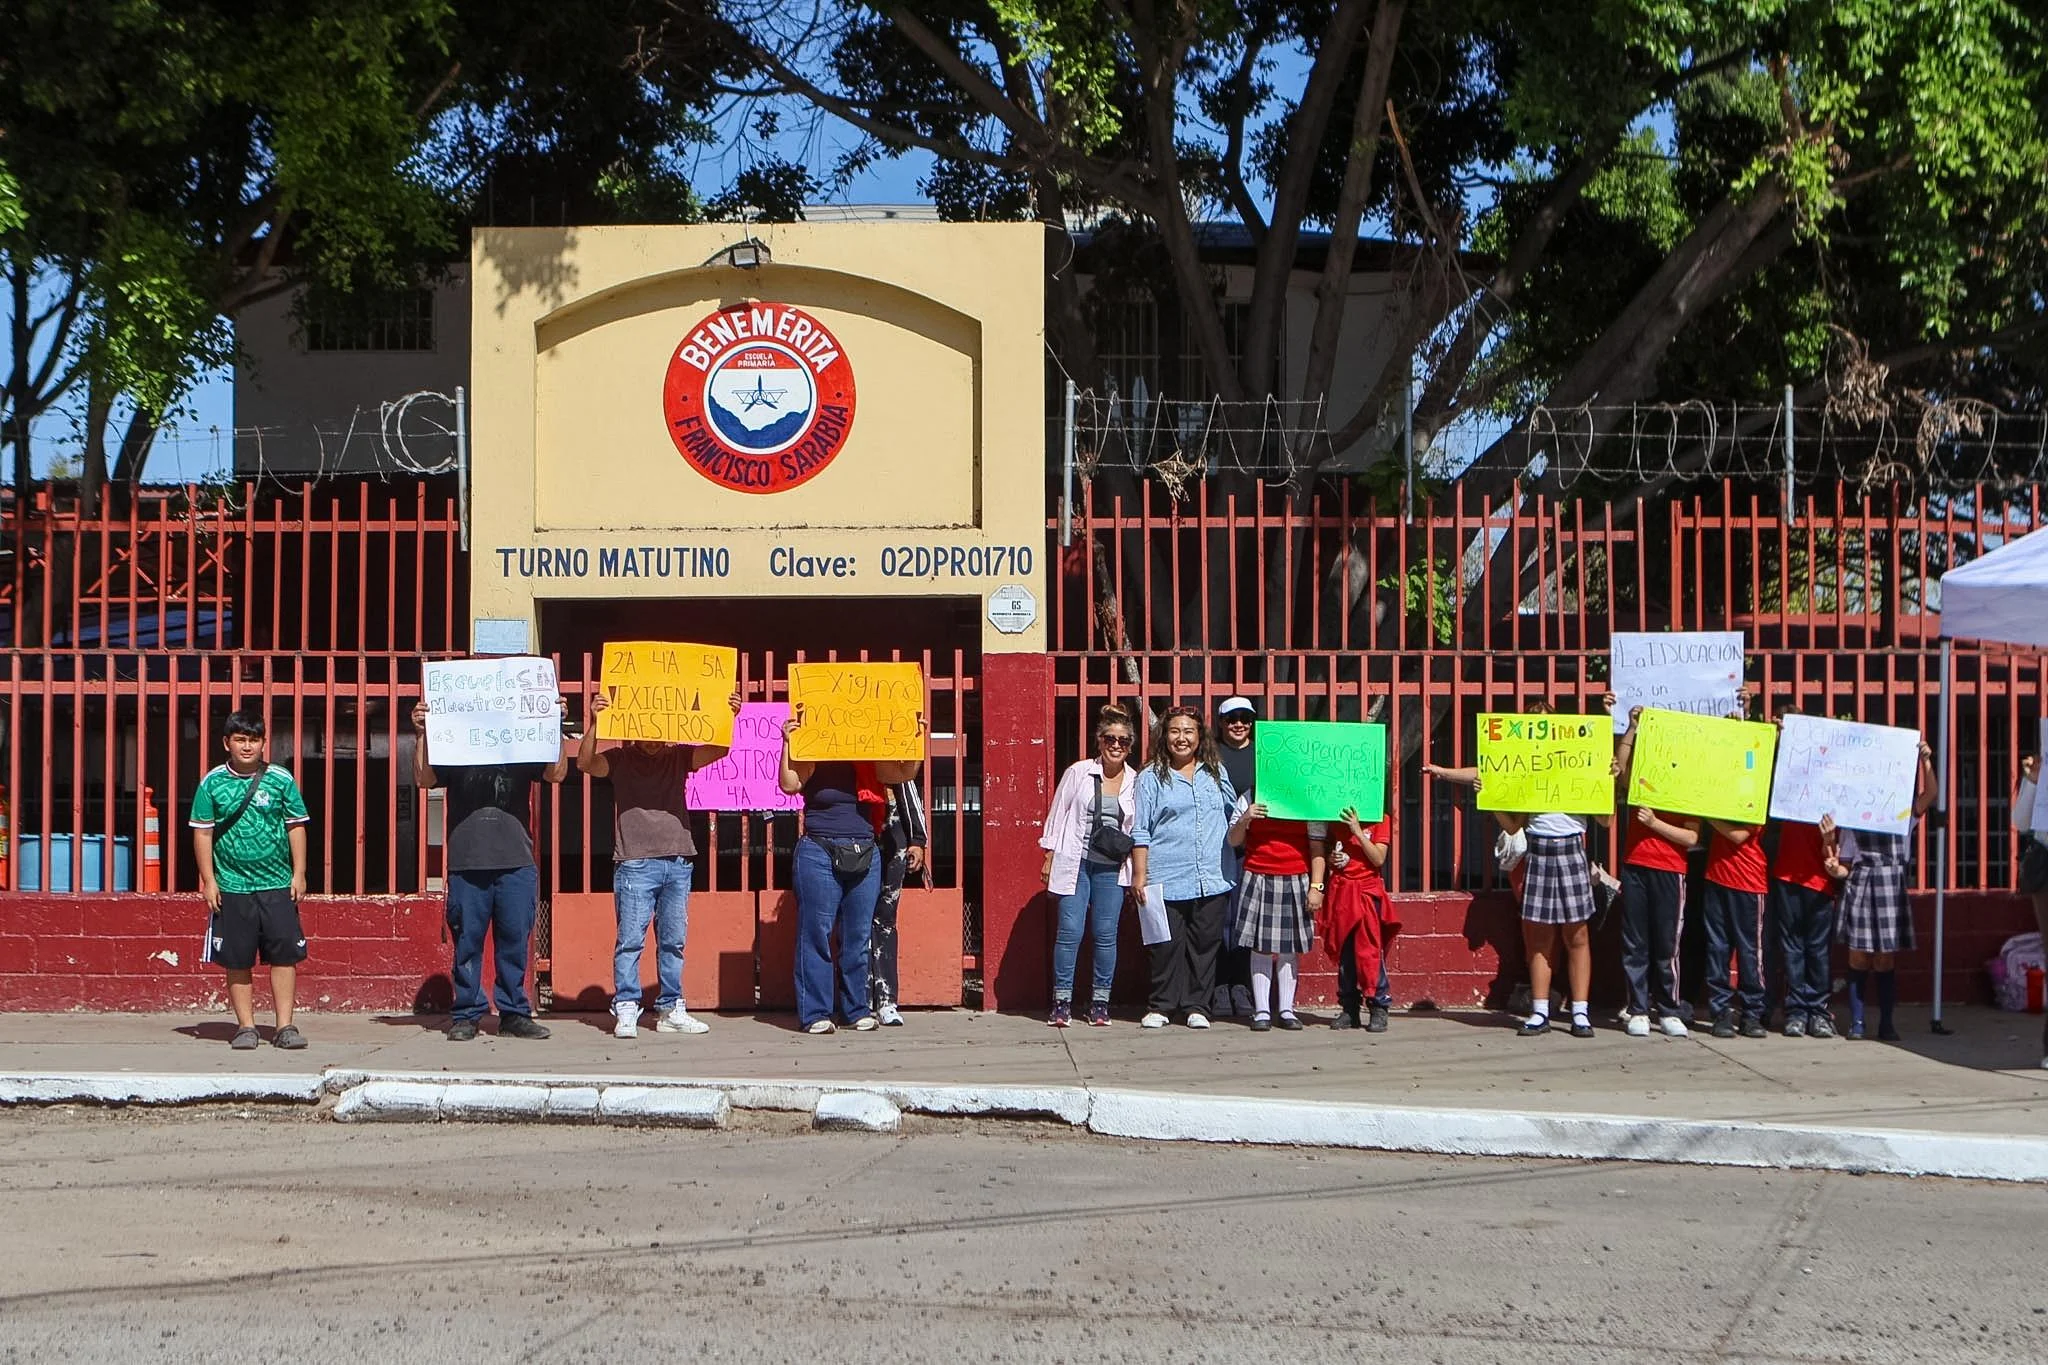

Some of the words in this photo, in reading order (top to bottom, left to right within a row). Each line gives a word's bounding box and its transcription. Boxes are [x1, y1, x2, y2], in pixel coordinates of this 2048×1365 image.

[679, 307, 839, 373] BENEMÉRITA
[744, 352, 773, 360] ESCUELA
[737, 360, 776, 368] PRIMARIA
[675, 415, 770, 487] FRANCISCO
[781, 404, 849, 481] SARABIA
[496, 547, 589, 578] TURNO
[600, 547, 731, 578] MATUTINO
[769, 546, 857, 578] Clave:
[608, 712, 715, 743] MAESTROS
[691, 749, 781, 781] AESTRO
